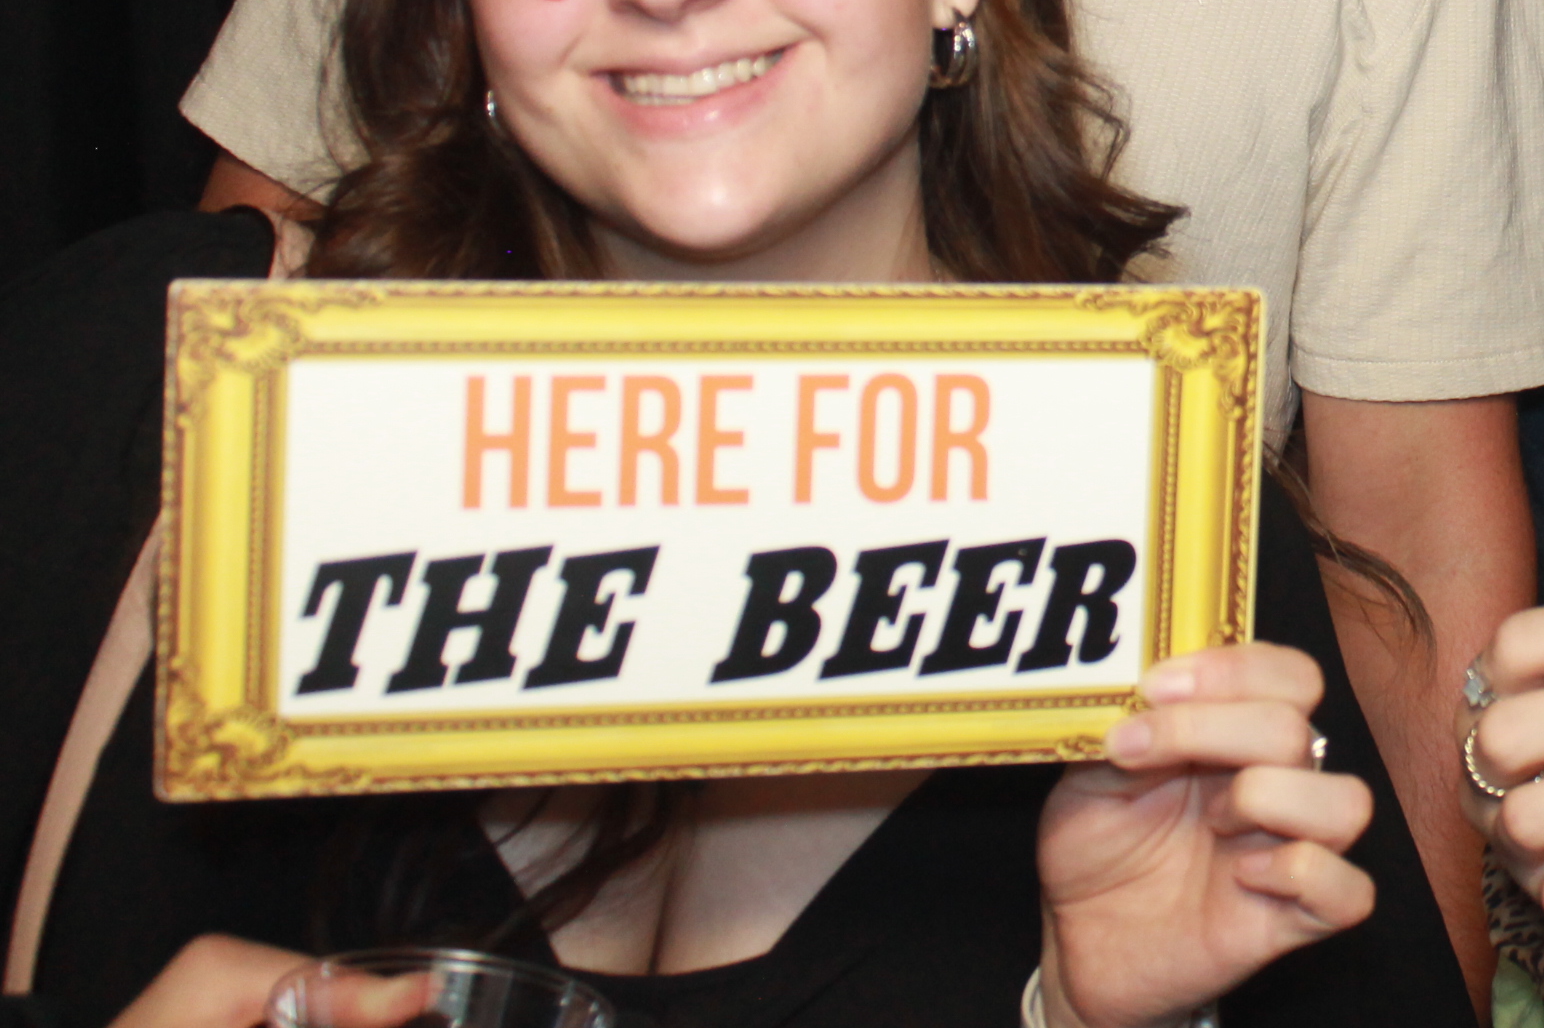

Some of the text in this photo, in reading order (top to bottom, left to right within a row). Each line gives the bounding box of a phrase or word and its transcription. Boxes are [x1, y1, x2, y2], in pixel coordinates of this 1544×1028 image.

[460, 373, 992, 510] HERE FOR
[294, 537, 1138, 696] THE BEER
